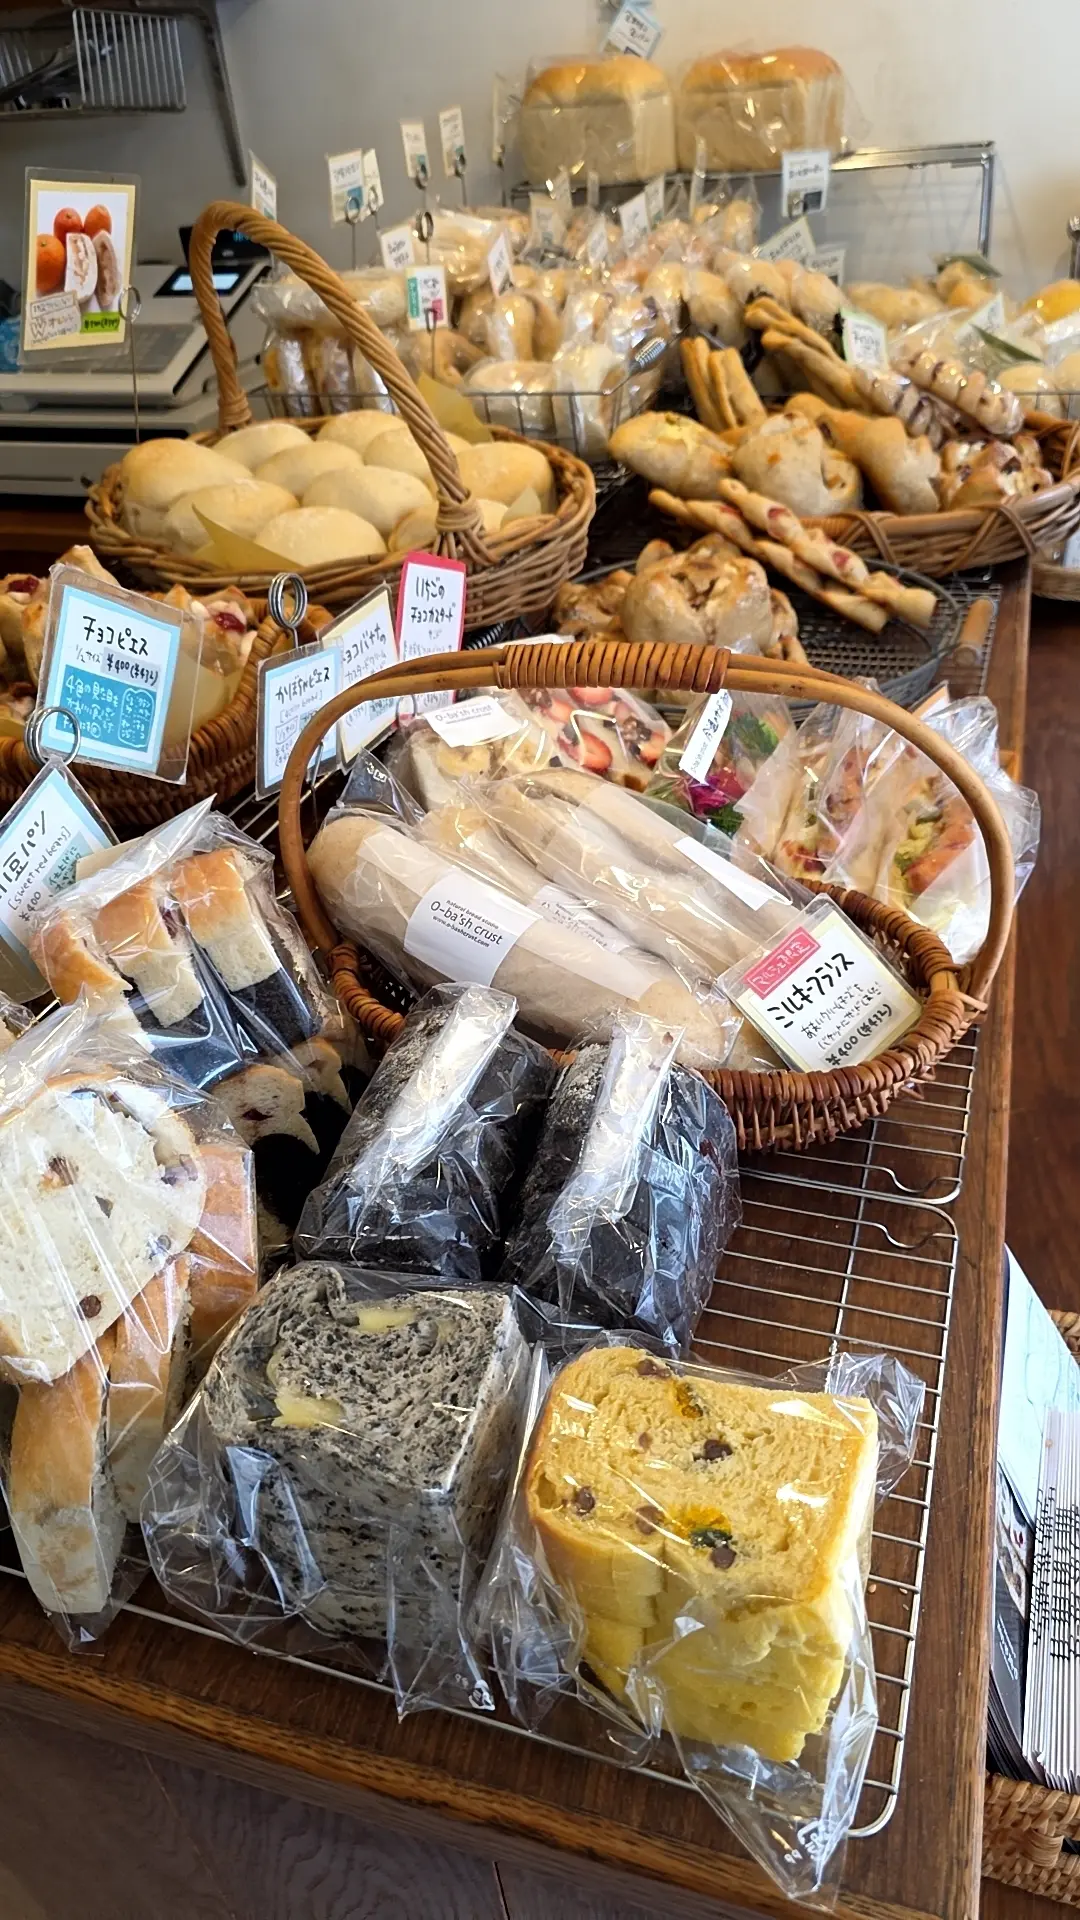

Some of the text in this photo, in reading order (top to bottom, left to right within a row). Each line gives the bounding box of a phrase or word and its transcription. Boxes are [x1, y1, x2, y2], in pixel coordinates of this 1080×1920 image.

[415, 576, 445, 602] いちごの
[410, 602, 456, 624] チョコカスタード
[82, 615, 149, 656] チョコピエス
[342, 622, 387, 664] ョコバナナの
[275, 666, 330, 705] かぼちゃピエス
[34, 854, 49, 874] red
[18, 891, 42, 922] ¥400
[430, 900, 503, 945] O-ba'sh crust
[446, 899, 499, 930] natural bread studio
[766, 952, 855, 1029] ミルキーフランス
